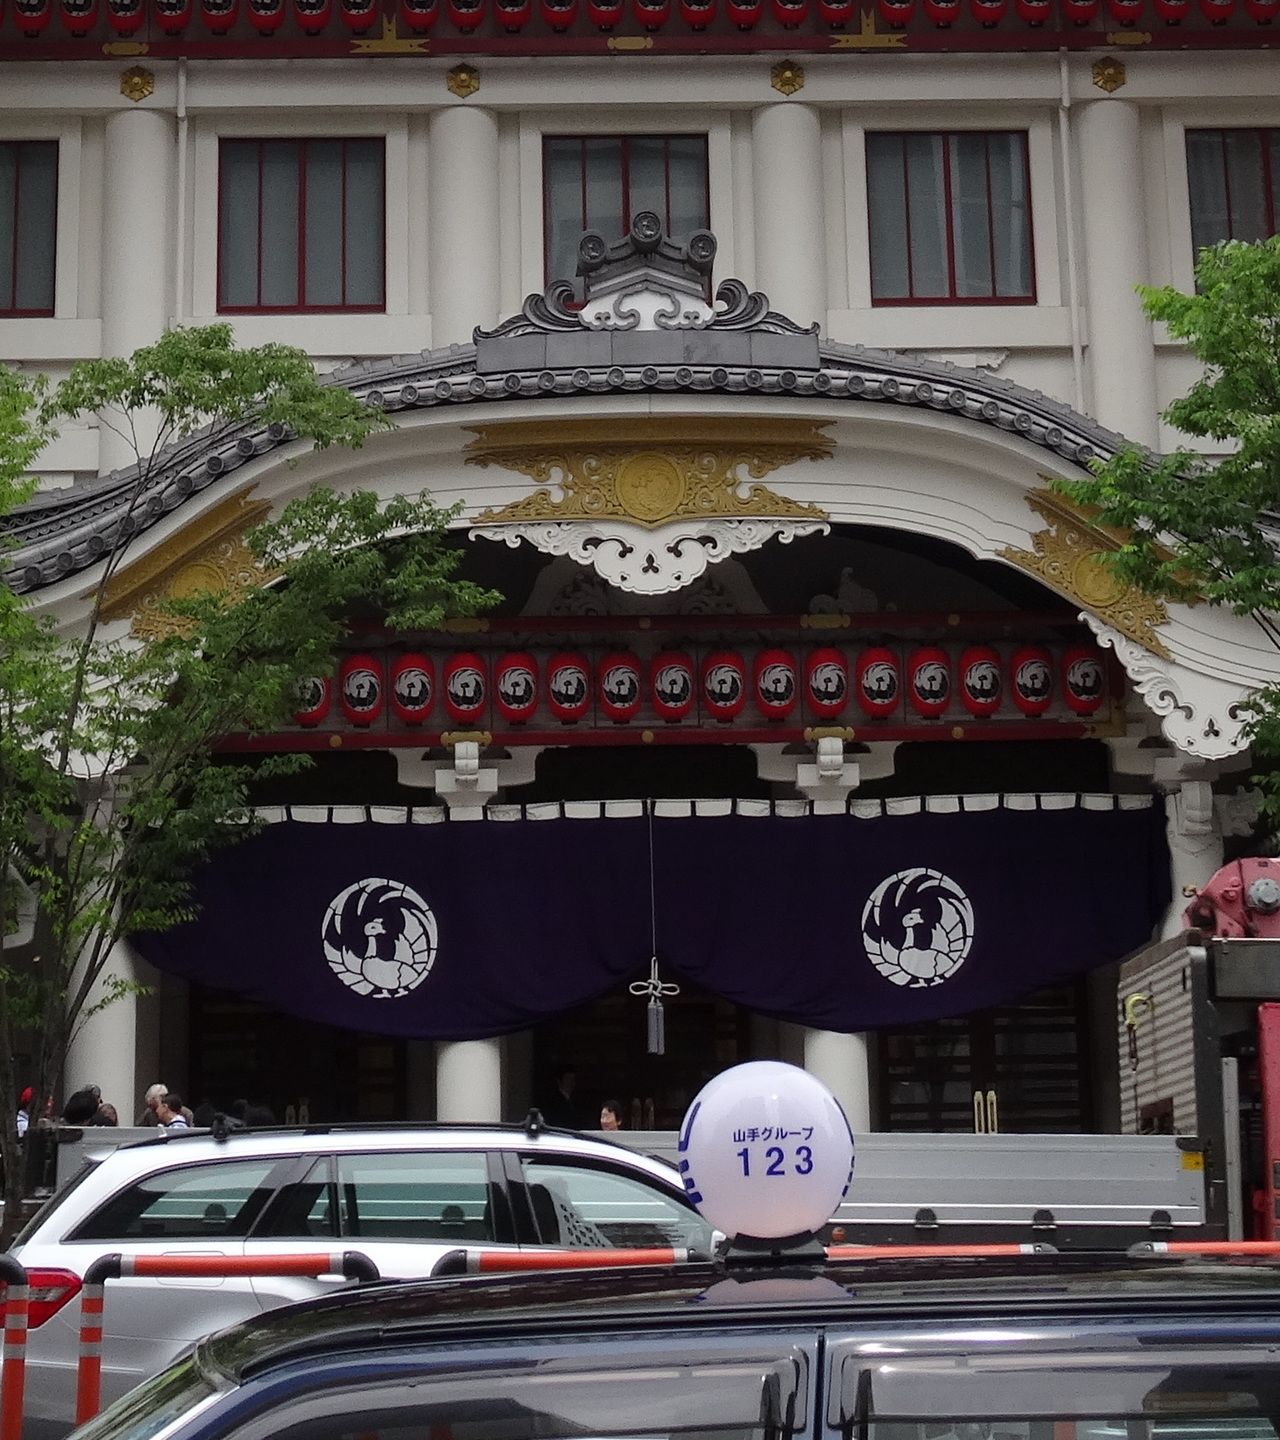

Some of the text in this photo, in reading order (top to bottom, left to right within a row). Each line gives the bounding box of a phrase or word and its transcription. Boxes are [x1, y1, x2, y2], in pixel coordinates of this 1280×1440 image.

[733, 1126, 815, 1143] 山手グループ
[736, 1146, 814, 1177] 123
